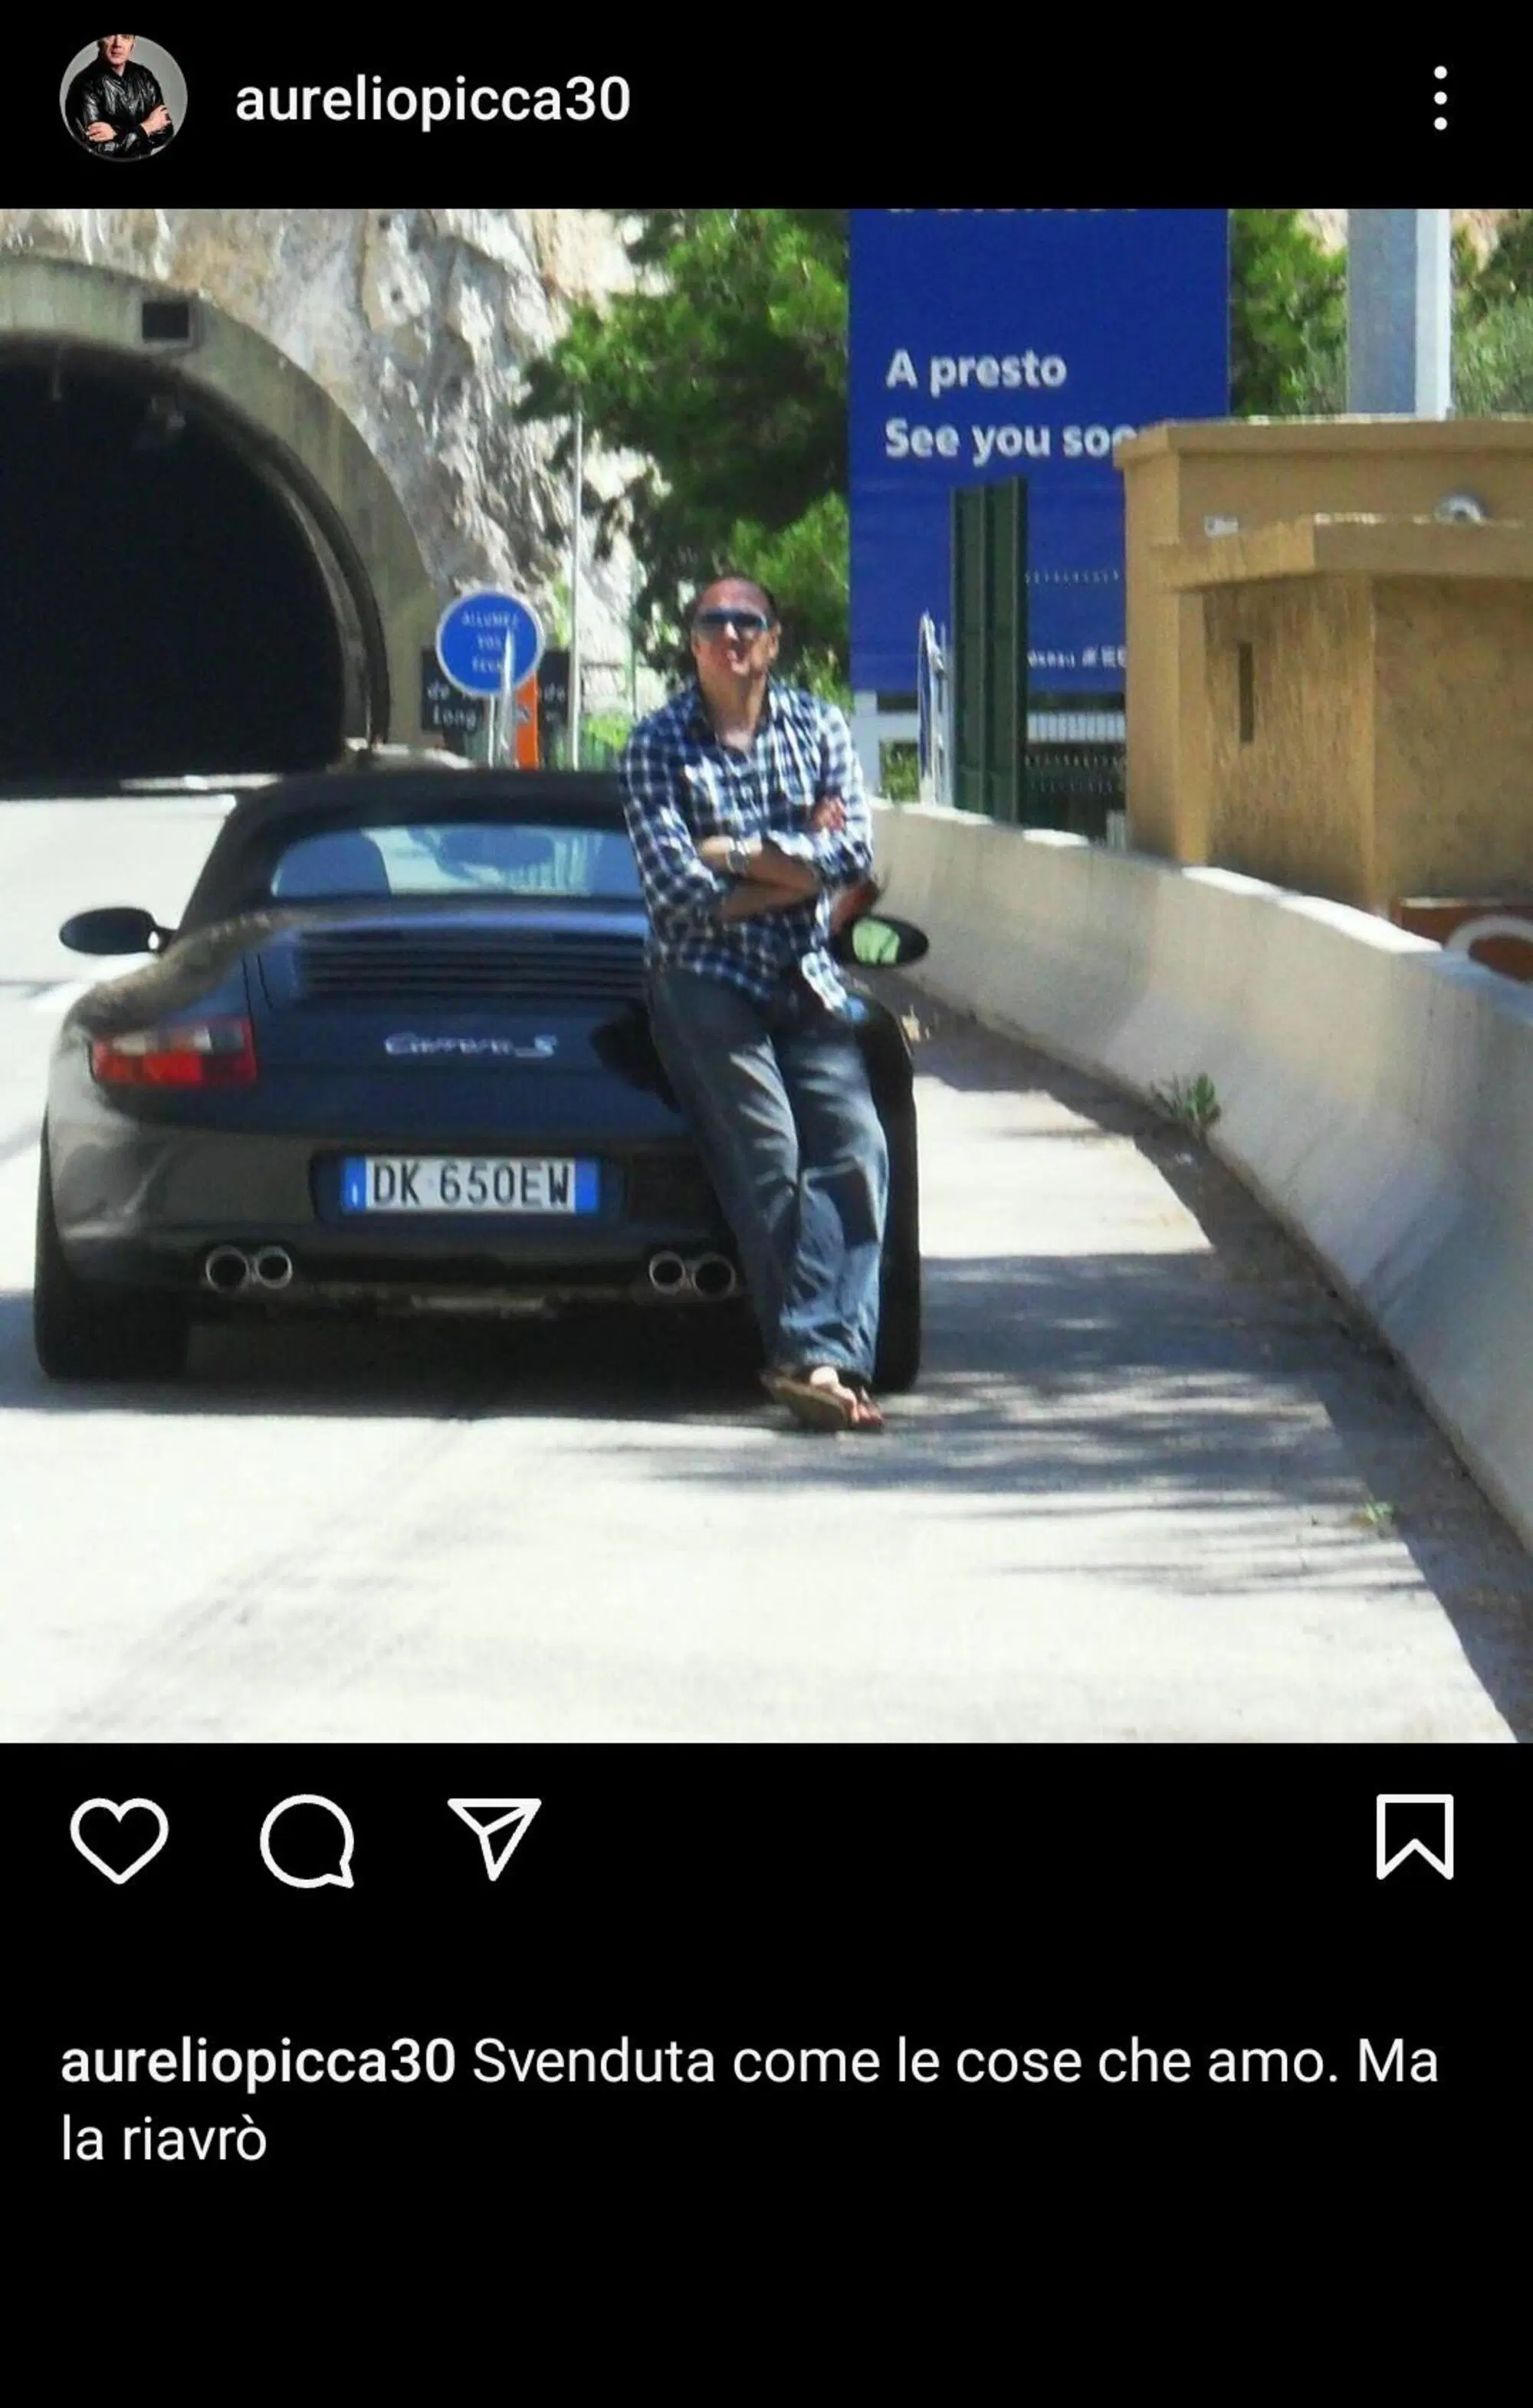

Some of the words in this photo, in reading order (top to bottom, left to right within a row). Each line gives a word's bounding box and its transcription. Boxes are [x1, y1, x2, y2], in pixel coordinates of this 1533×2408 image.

[886, 348, 918, 389] A
[930, 346, 1067, 399] presto
[885, 418, 958, 458] See
[971, 424, 1051, 468] you
[1062, 423, 1145, 458] soo
[373, 1162, 421, 1206] DK
[439, 1162, 570, 1207] 650EW
